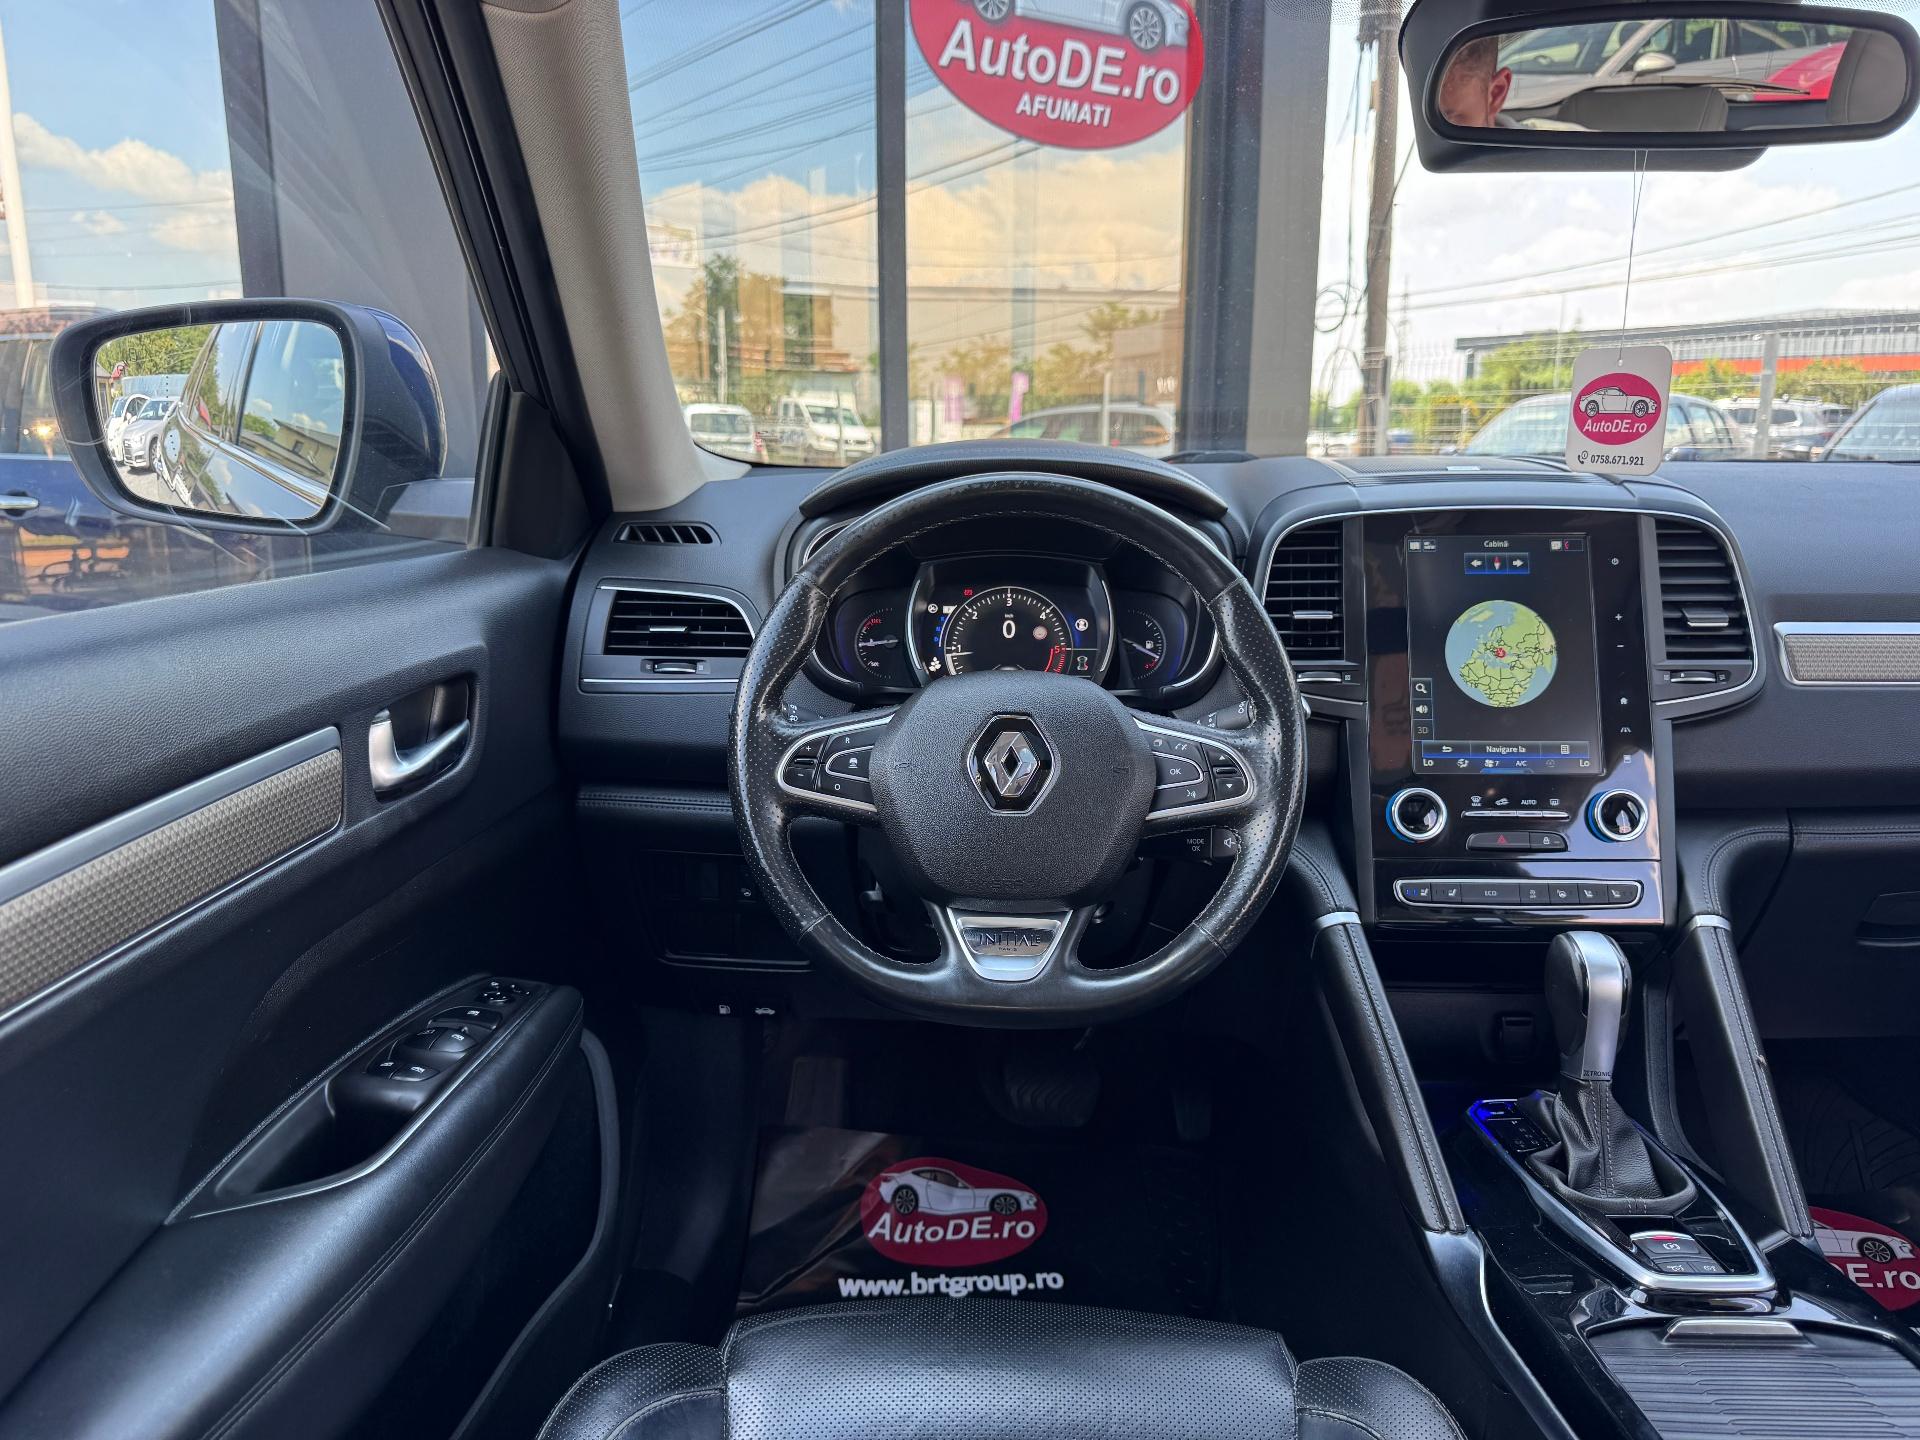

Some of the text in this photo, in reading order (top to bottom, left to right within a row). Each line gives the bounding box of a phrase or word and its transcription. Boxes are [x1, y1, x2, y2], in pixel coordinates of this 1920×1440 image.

[939, 19, 1179, 104] AutoDE.ro
[1016, 92, 1111, 127] AFUMATI
[1583, 419, 1647, 433] AutoDE.ro
[1590, 454, 1645, 466] 0758.671.921
[1006, 598, 1013, 607] 3
[972, 611, 978, 621] 2
[1039, 612, 1047, 620] 4
[1002, 620, 1016, 639] 0
[1417, 726, 1428, 734] 3D
[1486, 745, 1526, 755] Navigare la
[1423, 758, 1434, 767] Lo
[1579, 759, 1590, 767] Lo
[868, 1212, 1036, 1243] AutoDE.ro
[838, 1271, 1064, 1297] www.brtgroup.ro
